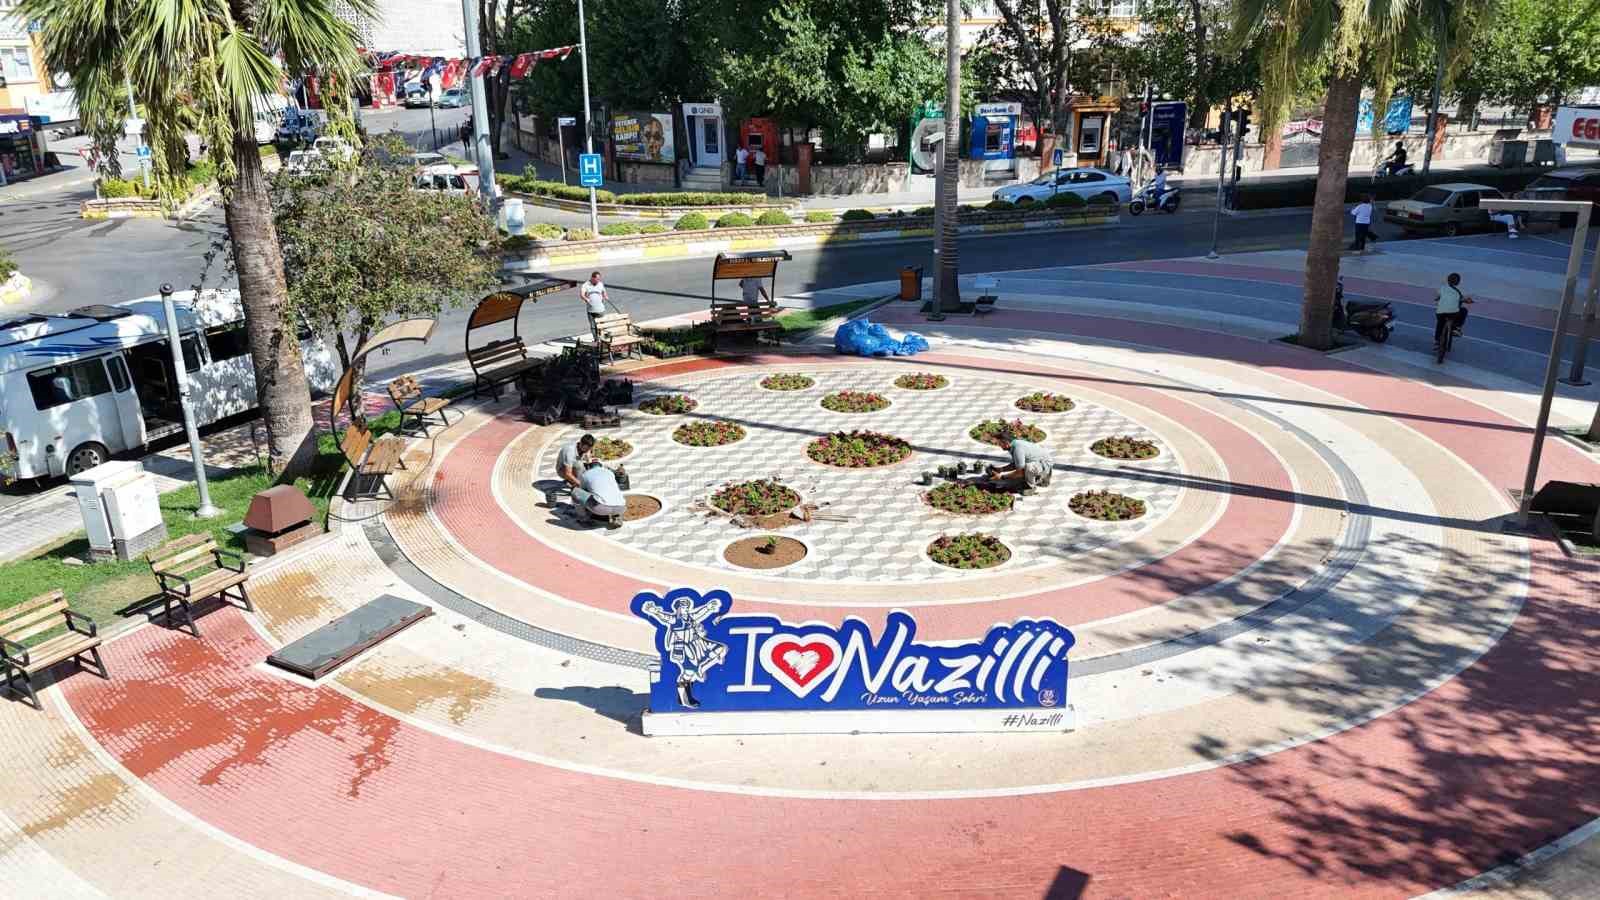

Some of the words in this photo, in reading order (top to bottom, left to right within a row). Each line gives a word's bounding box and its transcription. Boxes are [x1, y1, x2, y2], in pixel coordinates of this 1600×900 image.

[584, 157, 597, 174] H
[726, 626, 774, 693] I
[820, 622, 1066, 703] Nazilli
[861, 692, 899, 706] Uzun
[1002, 712, 1063, 728] #Nazilli
